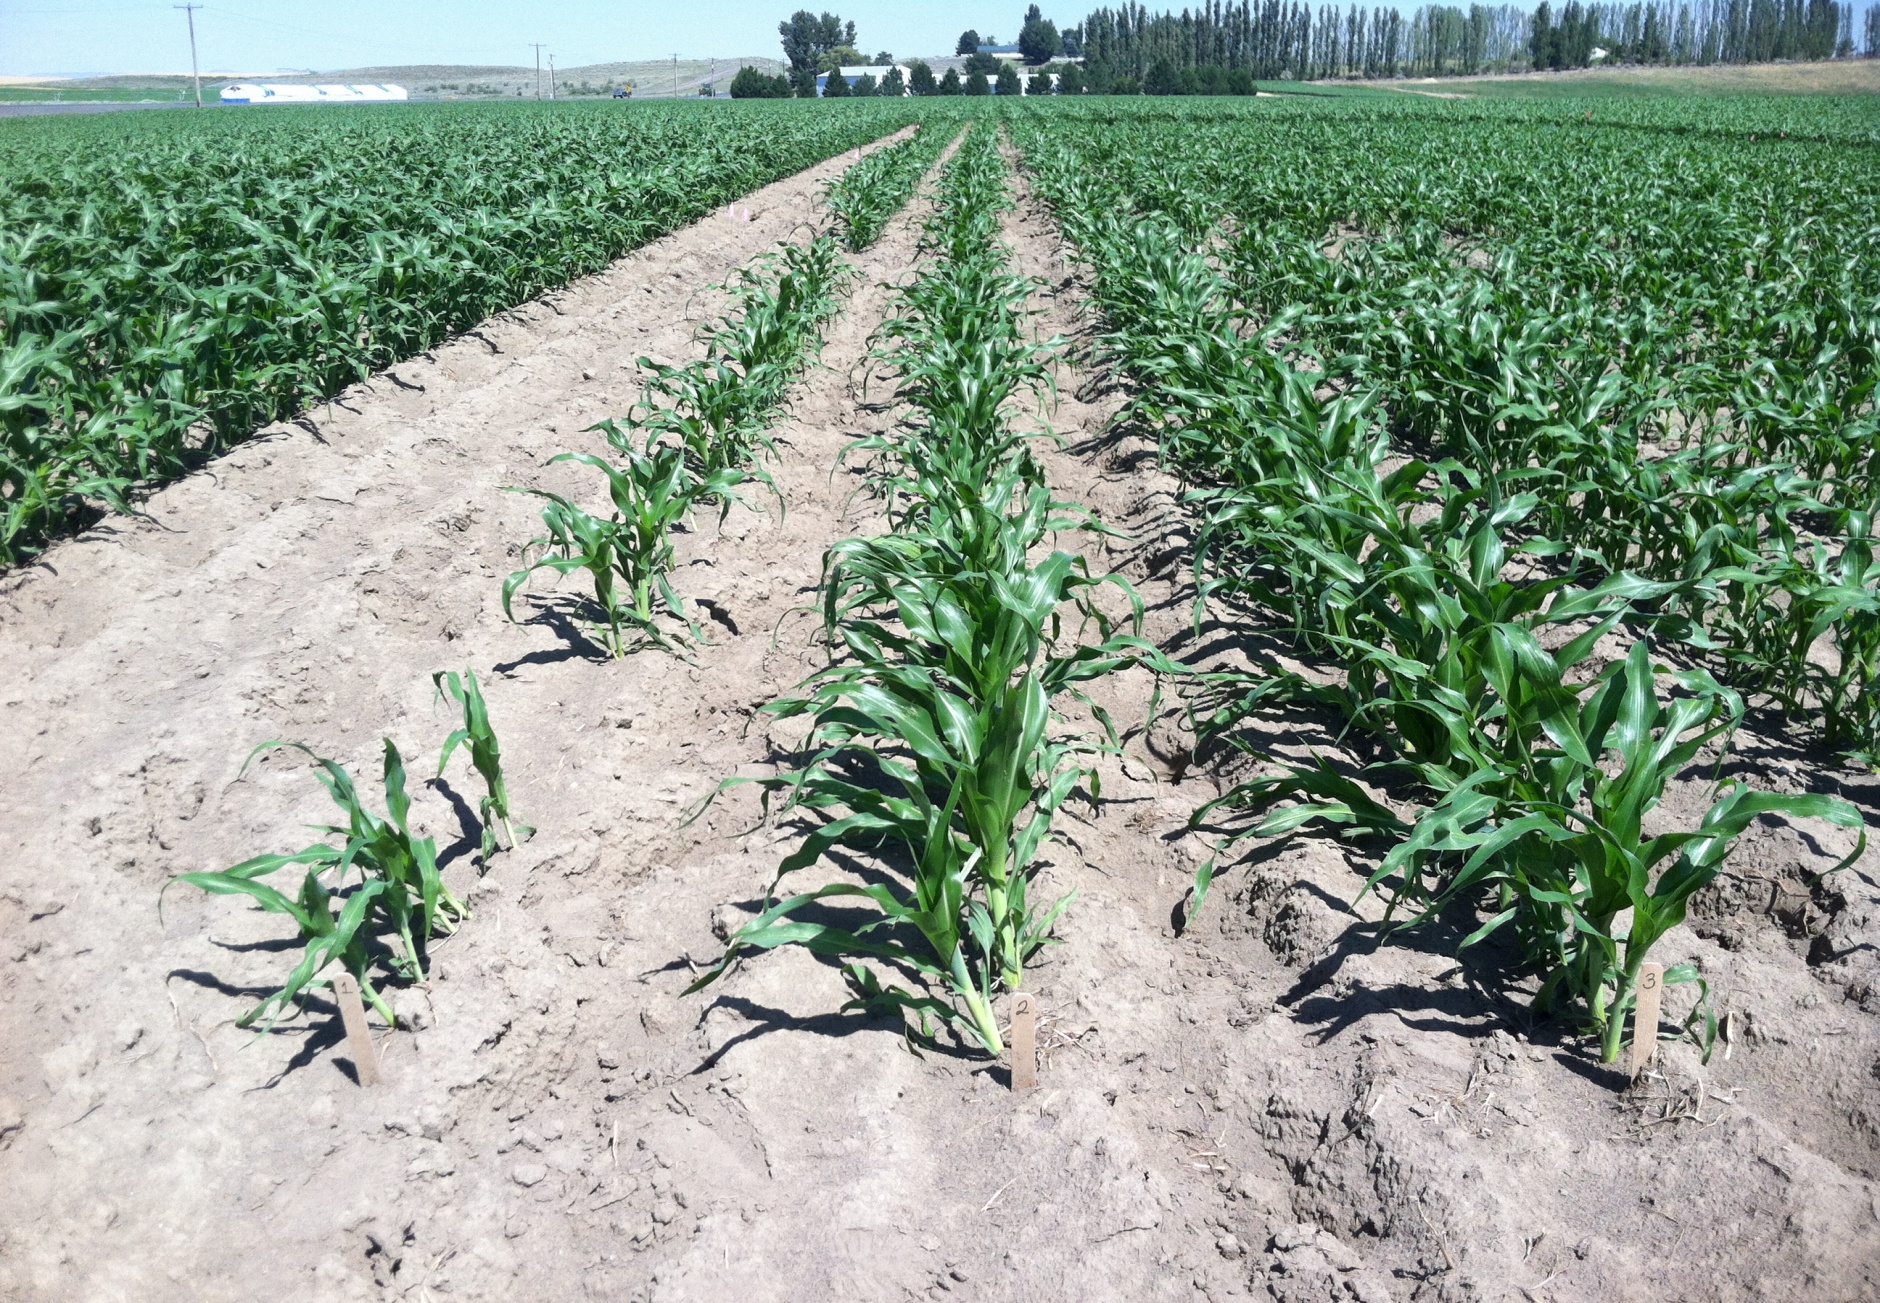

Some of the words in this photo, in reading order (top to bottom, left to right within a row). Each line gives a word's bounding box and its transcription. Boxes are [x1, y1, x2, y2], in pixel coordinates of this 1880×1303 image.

[341, 981, 354, 994] 1
[1642, 972, 1656, 990] 3
[1015, 999, 1030, 1016] 2
